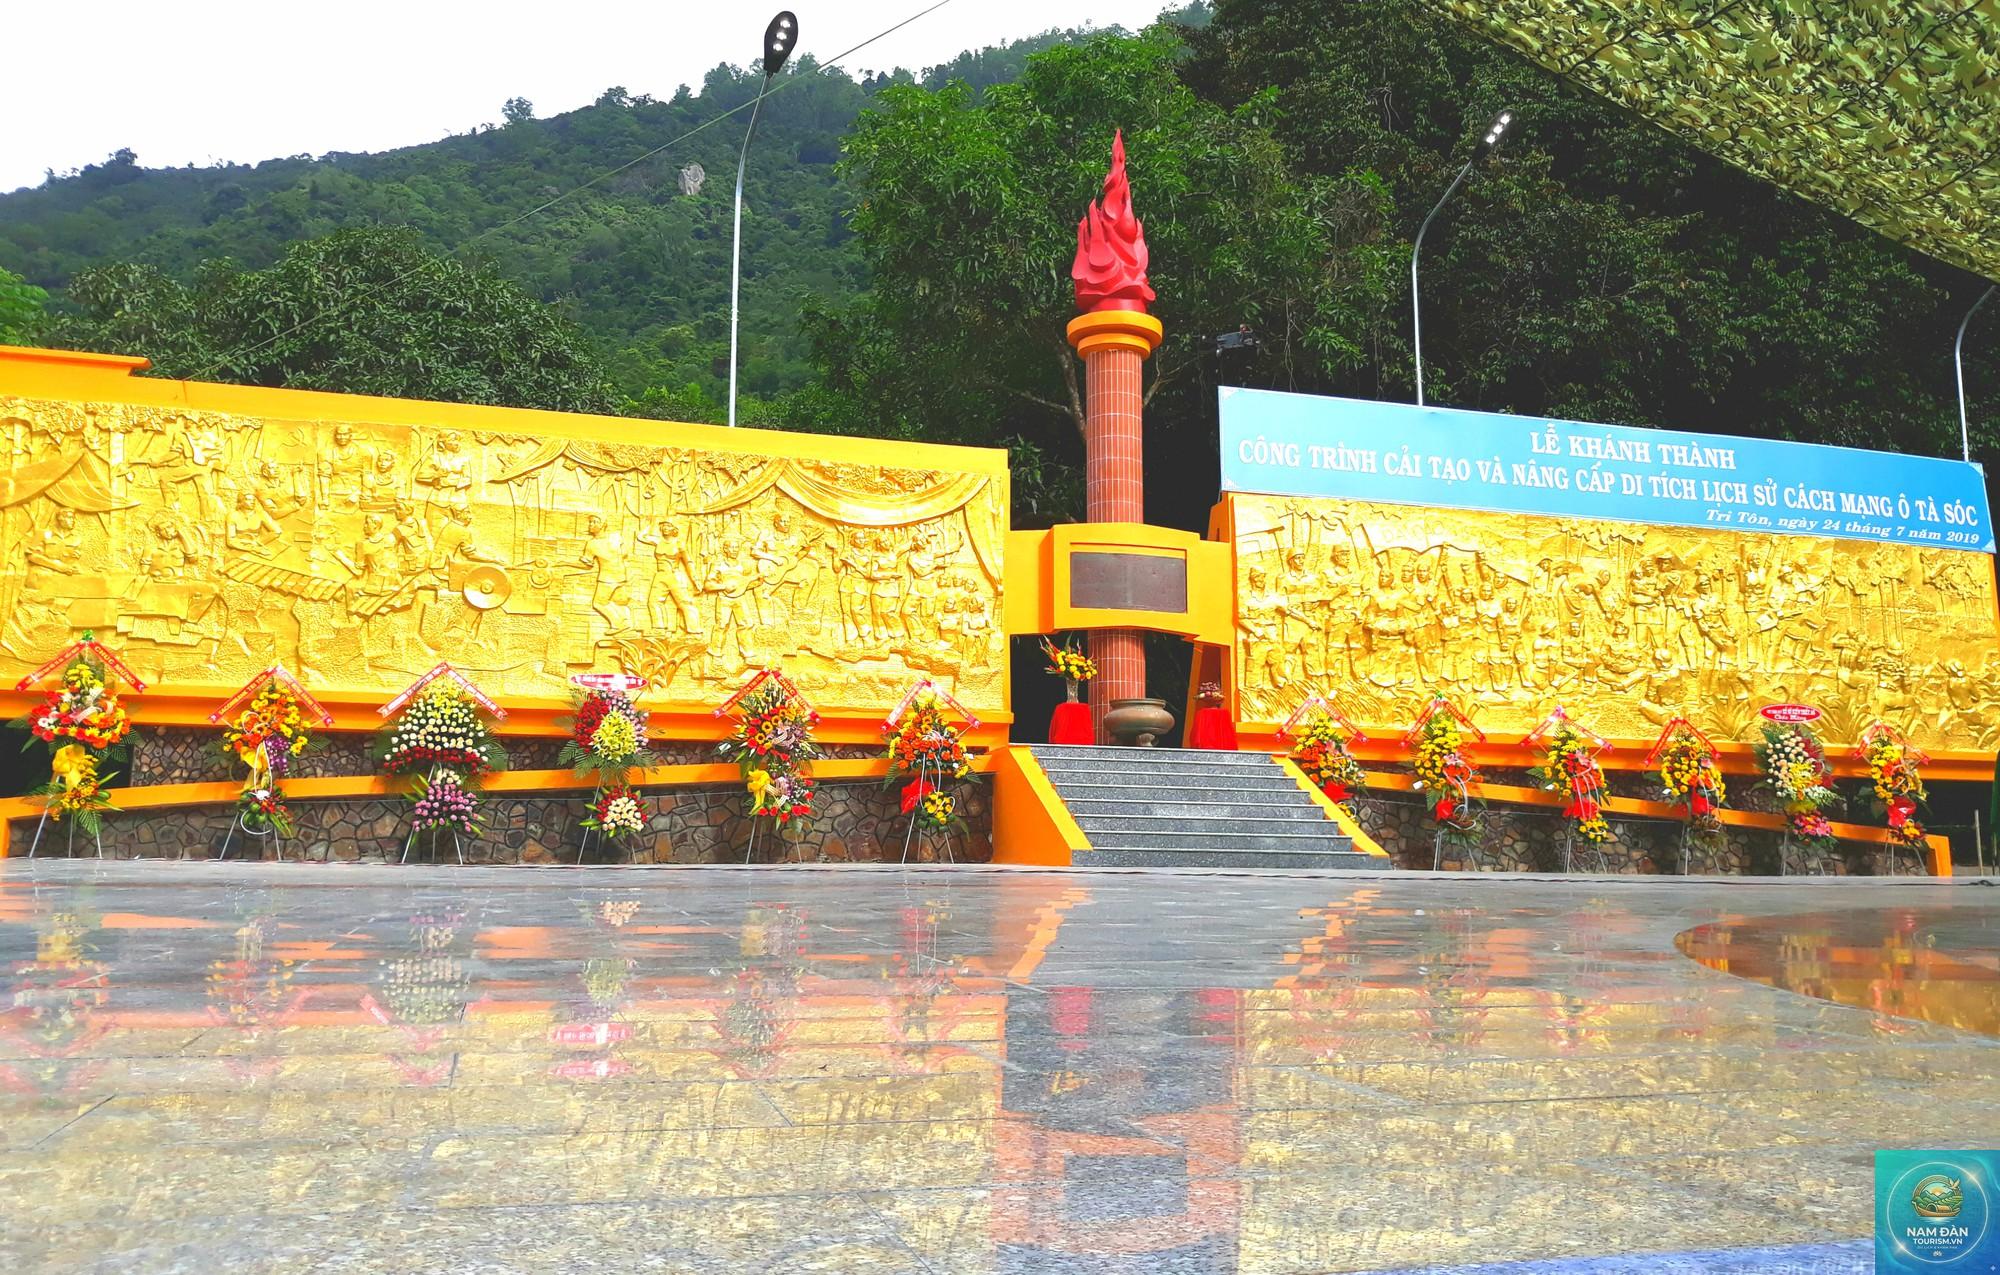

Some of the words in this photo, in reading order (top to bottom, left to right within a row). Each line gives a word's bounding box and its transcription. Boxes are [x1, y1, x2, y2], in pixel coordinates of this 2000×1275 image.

[1530, 422, 1561, 455] LỄ
[1568, 433, 1651, 463] KHÁNH
[1657, 441, 1736, 470] THÀNH
[1239, 435, 1300, 467] CÔNG
[1307, 440, 1377, 474] TRÌNH
[1383, 444, 1422, 478] CẢI
[1428, 455, 1471, 485] TẠO
[1476, 456, 1506, 484] VÀ
[1511, 459, 1569, 490] NÂNG
[1575, 461, 1616, 493] CẤP
[1621, 473, 1644, 497] DI
[1648, 471, 1697, 501] TÍCH
[1703, 480, 1749, 507] LỊCH
[1753, 477, 1777, 507] SỬ
[1783, 482, 1836, 512] CÁCH
[1840, 492, 1893, 520] MẠNG
[1898, 493, 1910, 519] Ô
[1915, 496, 1940, 522] TÀ
[1944, 499, 1978, 526] SÓC
[1706, 509, 1733, 522] Tri
[1738, 511, 1772, 527] Tôn,
[1776, 517, 1817, 531] ngày
[1822, 519, 1840, 531] 24
[1845, 521, 1892, 538] tháng
[1896, 525, 1904, 536] 7
[1908, 529, 1941, 540] năm
[1946, 531, 1980, 544] 2019
